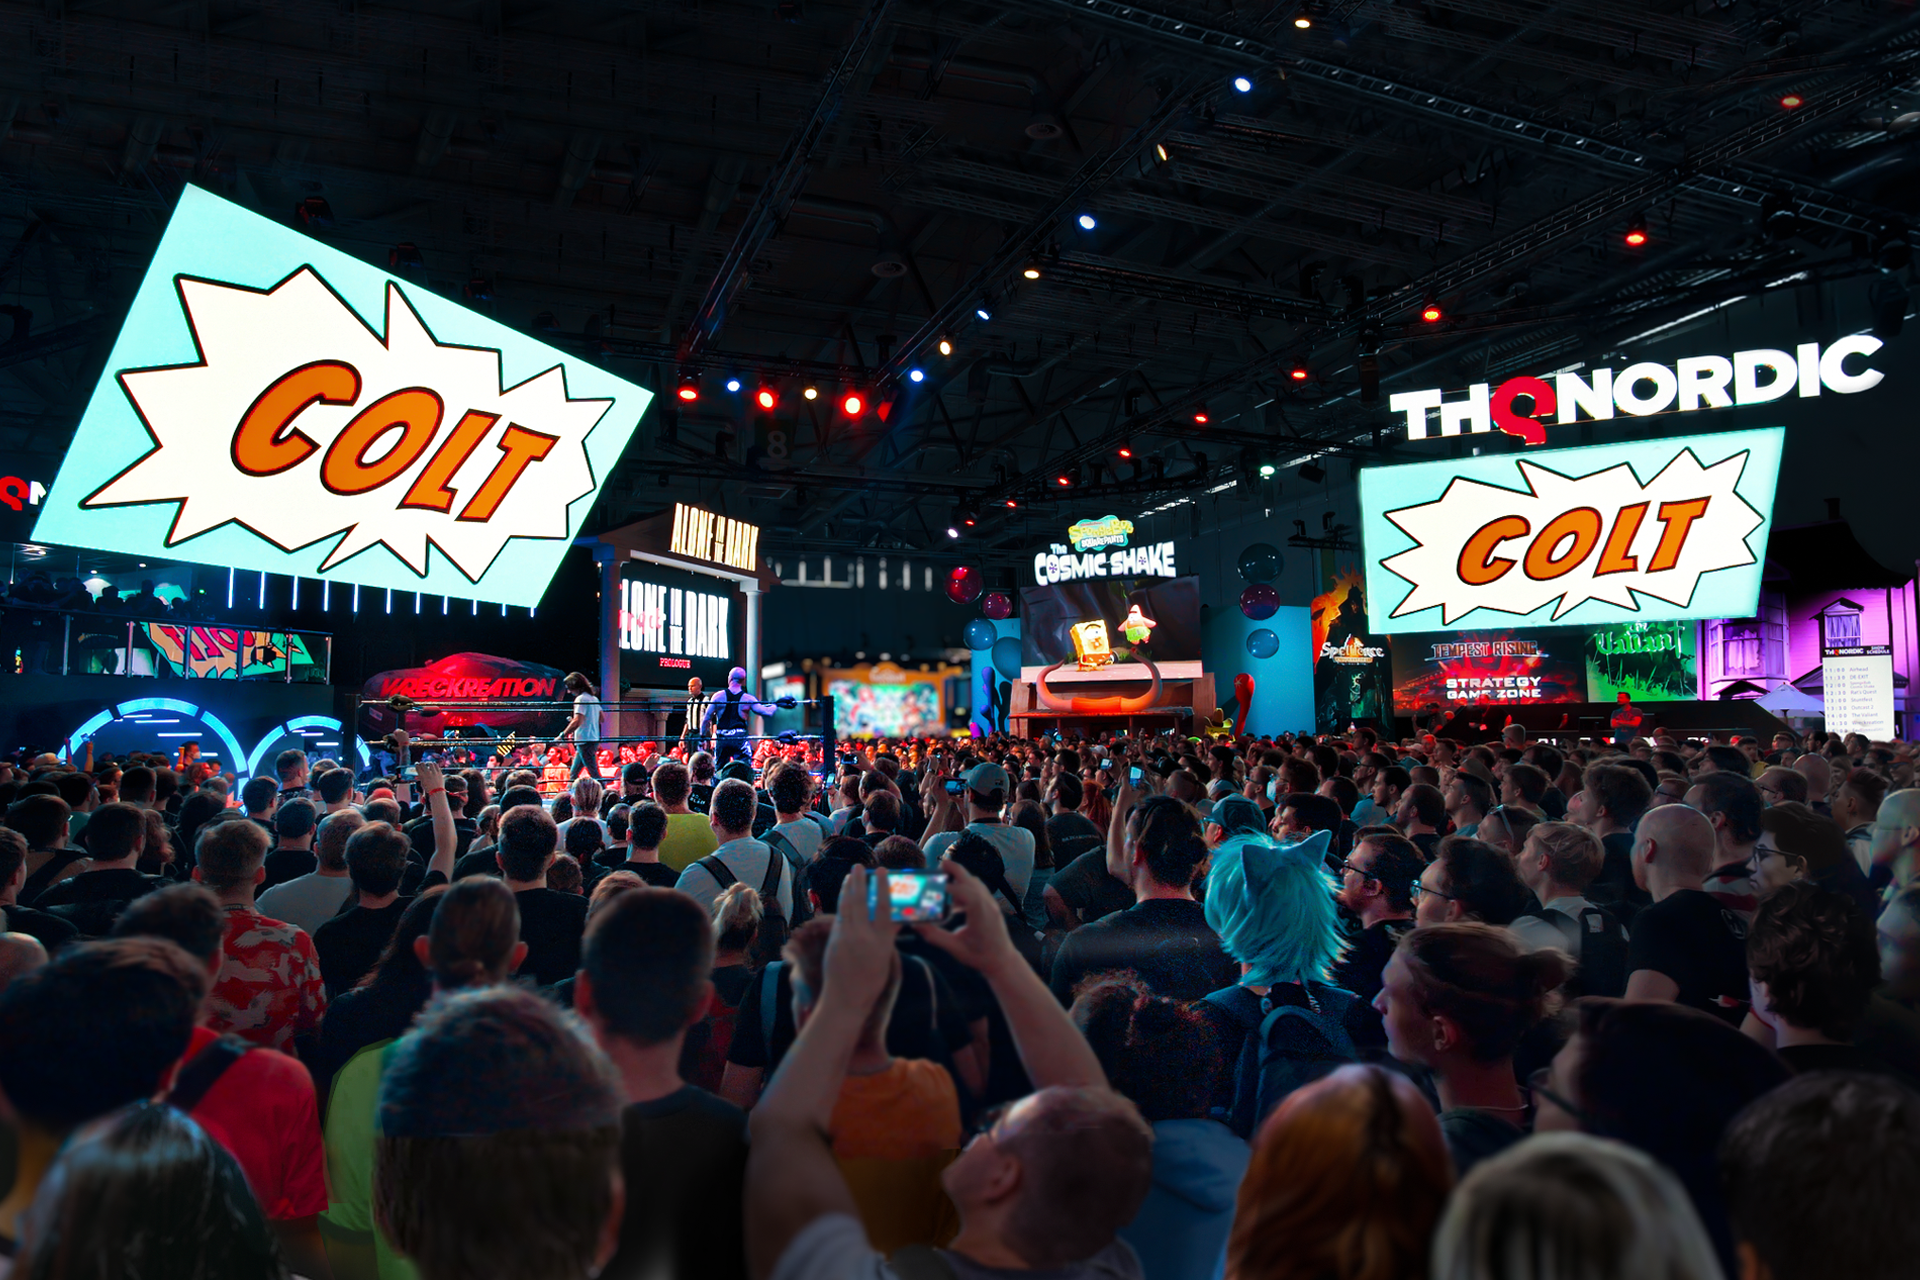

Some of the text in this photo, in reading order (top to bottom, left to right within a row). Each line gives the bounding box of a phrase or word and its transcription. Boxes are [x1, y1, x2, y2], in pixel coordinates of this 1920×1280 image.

[229, 358, 562, 524] COLT
[767, 430, 788, 459] 8
[670, 502, 716, 561] ALONE
[724, 518, 760, 572] DARK
[1050, 543, 1067, 555] The
[1456, 495, 1712, 586] COLT
[1034, 541, 1176, 586] COSMIC SHAKE
[619, 578, 667, 653] LONE
[685, 590, 729, 660] DARK
[1431, 640, 1539, 659] TEMPEST RISING
[659, 657, 691, 669] PROLOGUE
[379, 677, 557, 698] WRECKREATION
[1445, 676, 1542, 689] STRATEGY
[1496, 688, 1542, 699] ZONE
